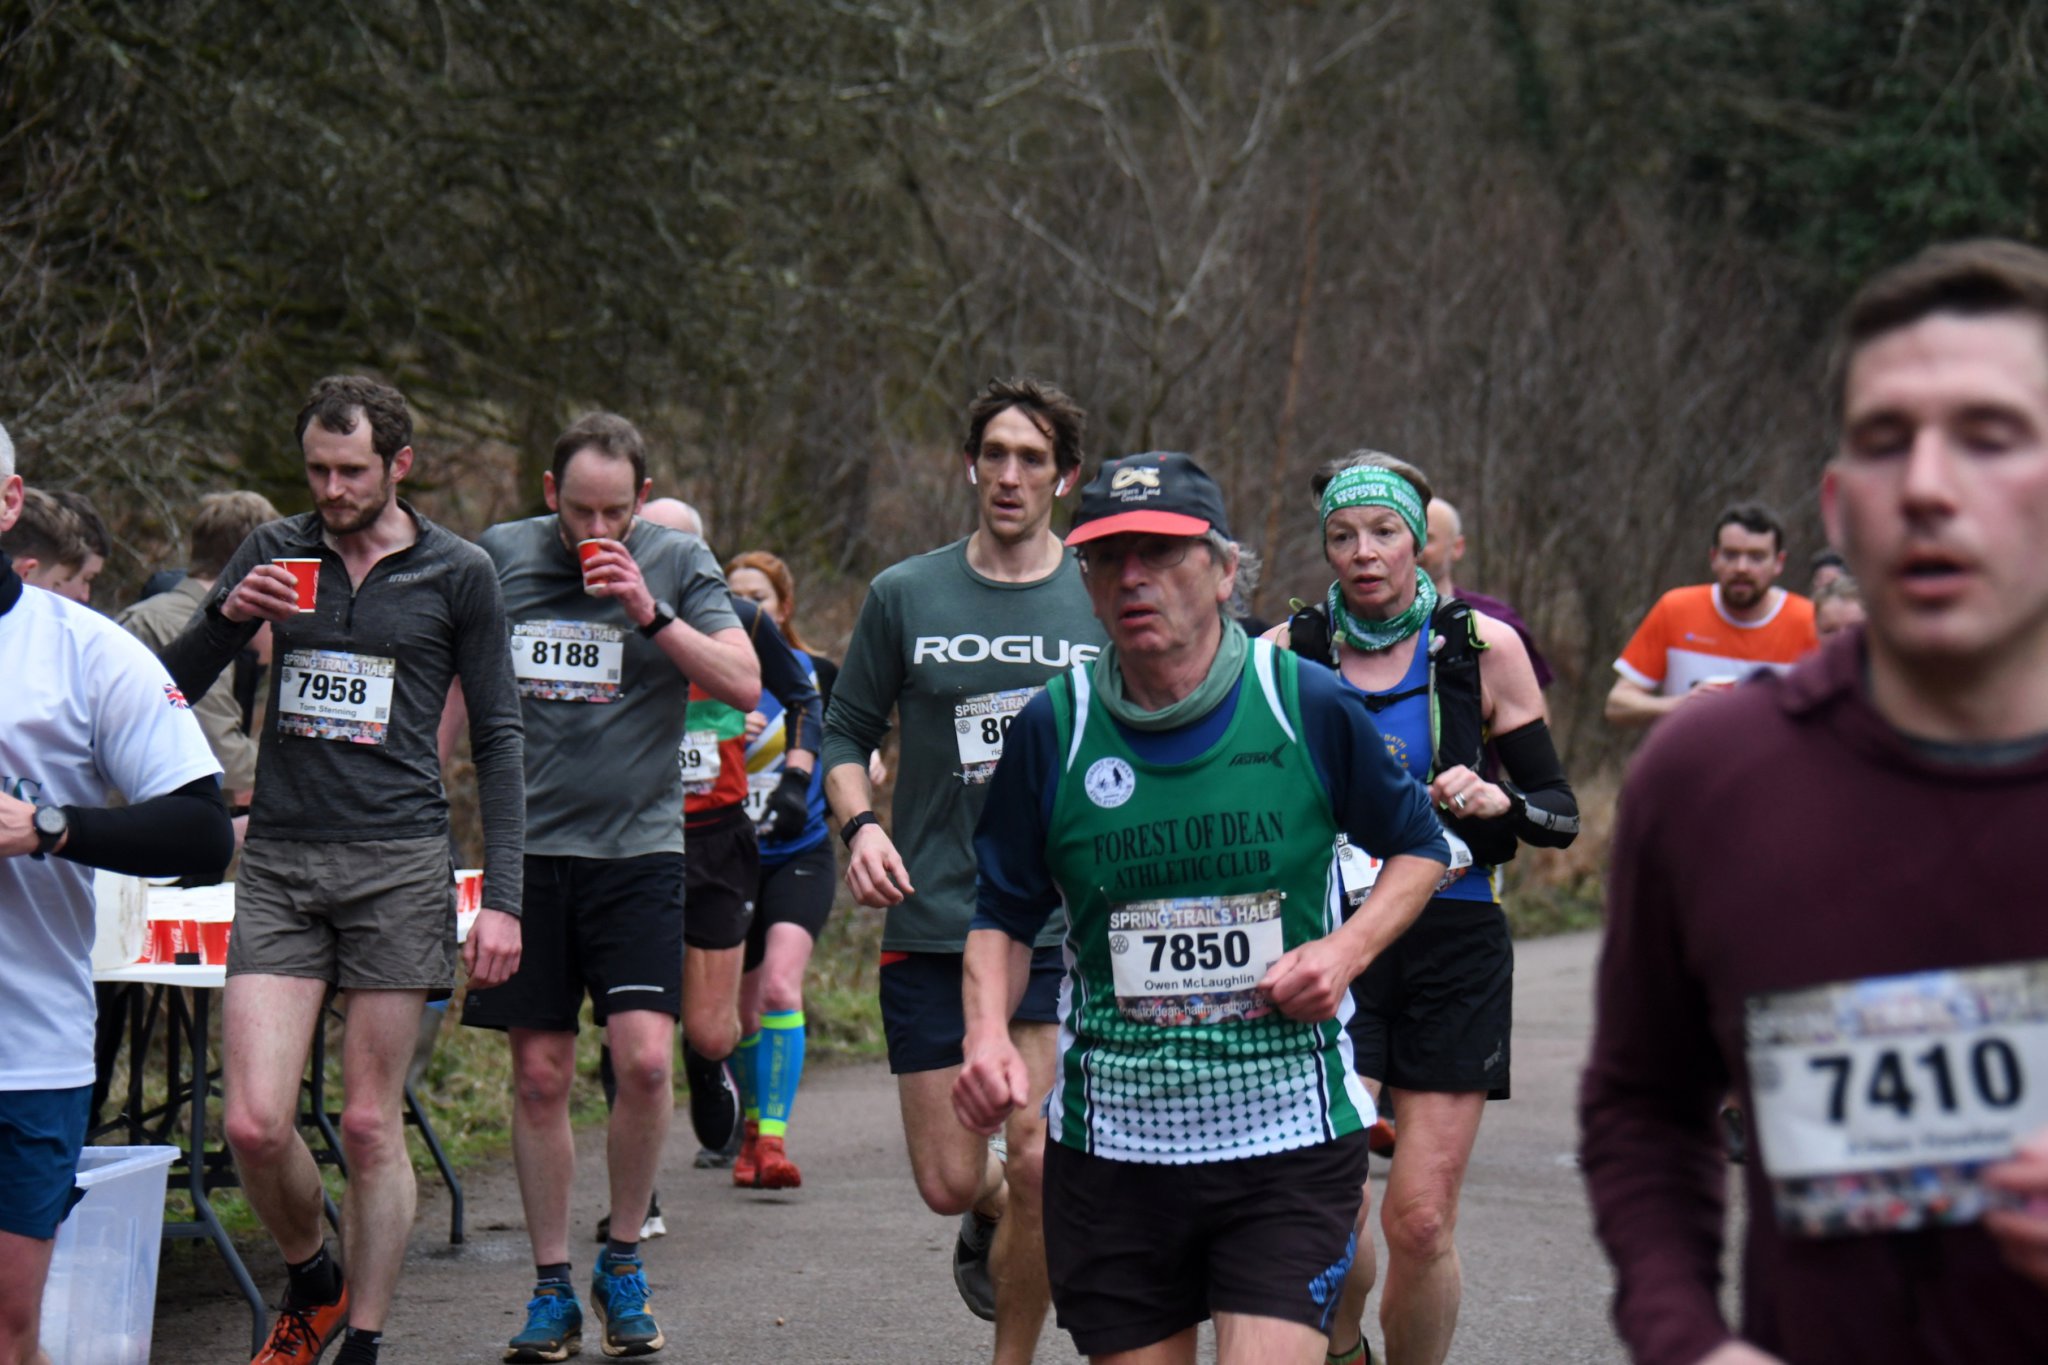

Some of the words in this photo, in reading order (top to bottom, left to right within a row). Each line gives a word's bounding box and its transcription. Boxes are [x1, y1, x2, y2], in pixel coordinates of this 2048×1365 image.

[513, 624, 552, 638] SPRING
[555, 627, 592, 640] TRAILS
[593, 628, 622, 642] HALF
[283, 653, 317, 670] SPRING
[320, 659, 359, 674] TRAILS
[361, 662, 394, 677] HALF
[532, 641, 599, 668] 8188
[913, 633, 1100, 668] ROGUE
[298, 671, 367, 705] 7958
[300, 702, 316, 712] Tom
[318, 705, 357, 717] Stenning
[955, 701, 998, 717] SPRING
[1094, 818, 1179, 865] FOREST
[1184, 813, 1216, 851] OF
[1221, 811, 1285, 847] DEAN
[1114, 855, 1212, 890] ATHLETIC
[1217, 849, 1272, 879] CLUB
[1110, 912, 1170, 930] SPRING
[1174, 908, 1232, 927] TRAILS
[1236, 901, 1277, 923] HALF
[1142, 930, 1251, 973] 7850
[1144, 979, 1179, 991] Owen
[1183, 974, 1255, 990] McLaughlin
[1808, 1036, 2024, 1124] 7410
